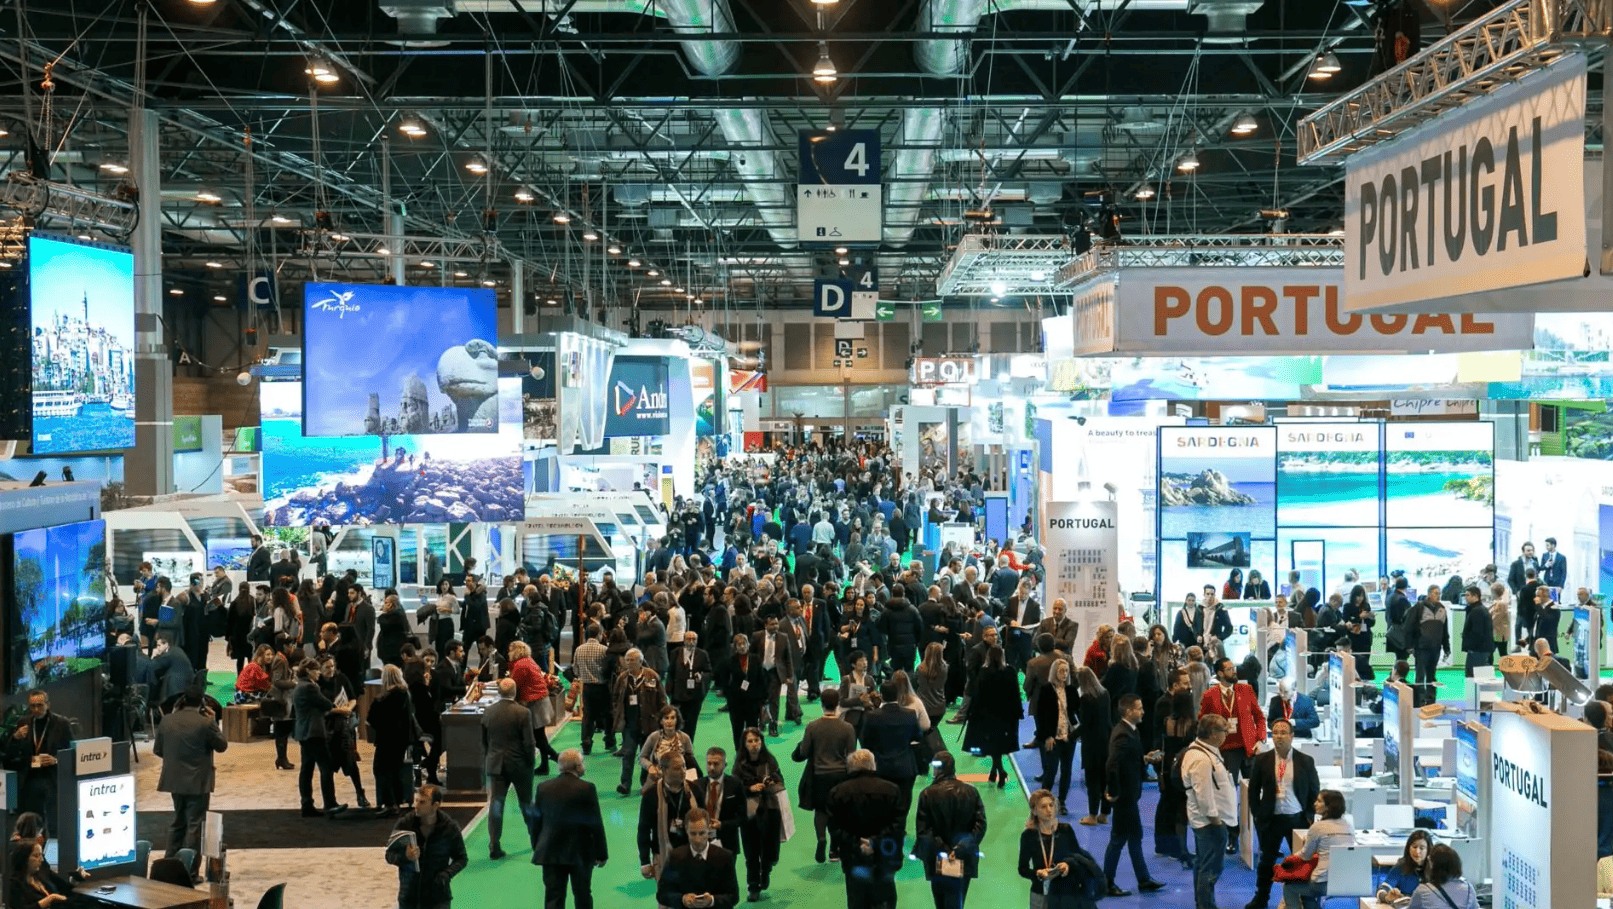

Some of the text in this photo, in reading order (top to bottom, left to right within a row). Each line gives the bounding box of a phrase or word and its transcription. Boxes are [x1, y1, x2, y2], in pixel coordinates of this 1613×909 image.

[843, 142, 870, 177] 4
[1359, 115, 1558, 281] PORTUGAL
[249, 276, 270, 305] C
[860, 271, 874, 289] 4
[821, 284, 845, 312] D
[179, 352, 191, 364] A
[1049, 518, 1115, 529] PORTUGAL
[80, 751, 102, 763] intra
[89, 783, 117, 797] intra
[1493, 751, 1548, 809] PORTUGAL
